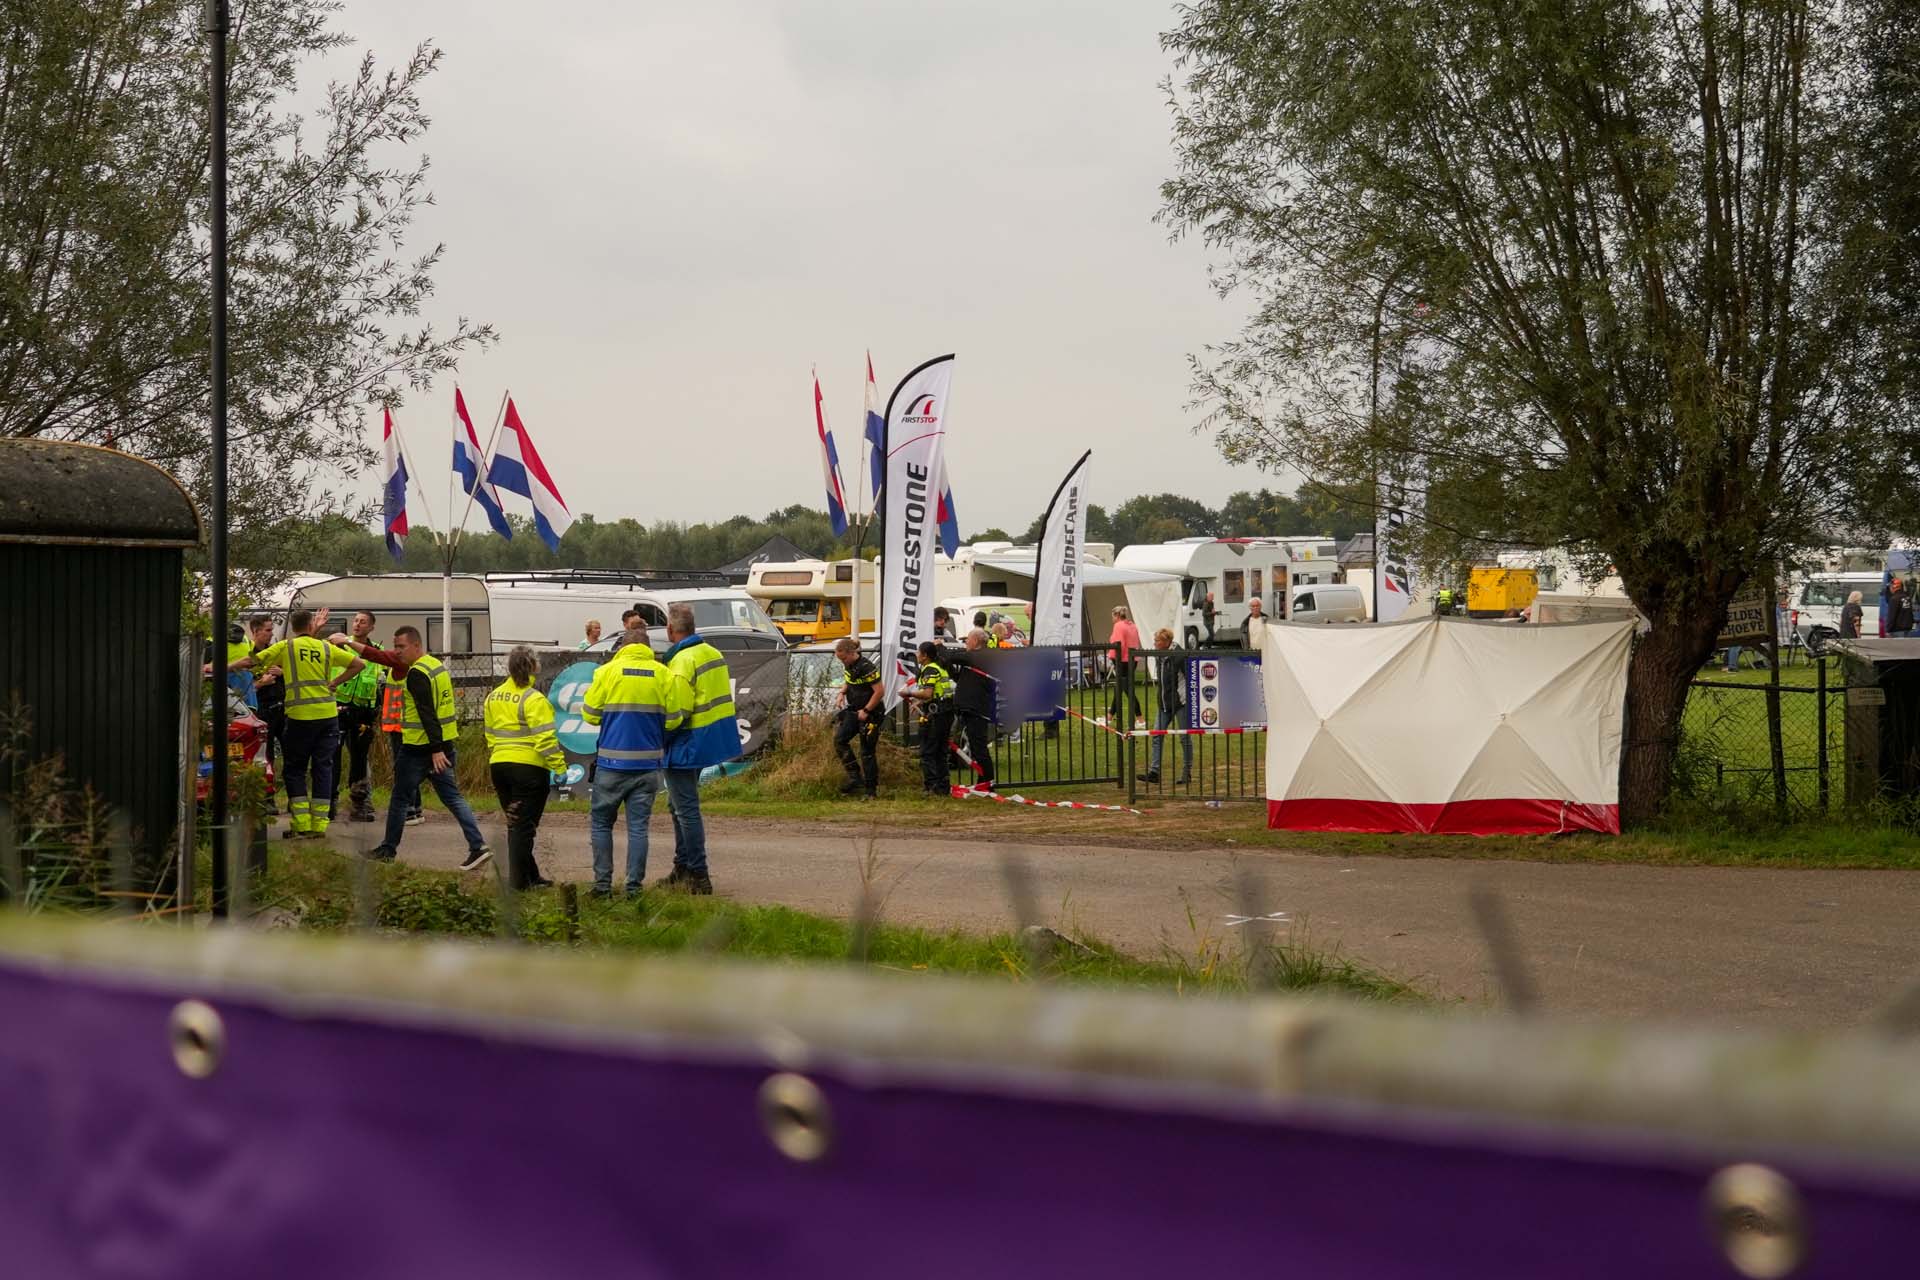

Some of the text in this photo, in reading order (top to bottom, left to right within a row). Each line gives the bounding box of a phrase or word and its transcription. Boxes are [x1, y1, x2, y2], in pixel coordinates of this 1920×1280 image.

[897, 462, 928, 674] BRIDGESTONE
[1727, 607, 1762, 620] ELDEN
[300, 648, 321, 663] FR
[489, 691, 520, 703] EHBO
